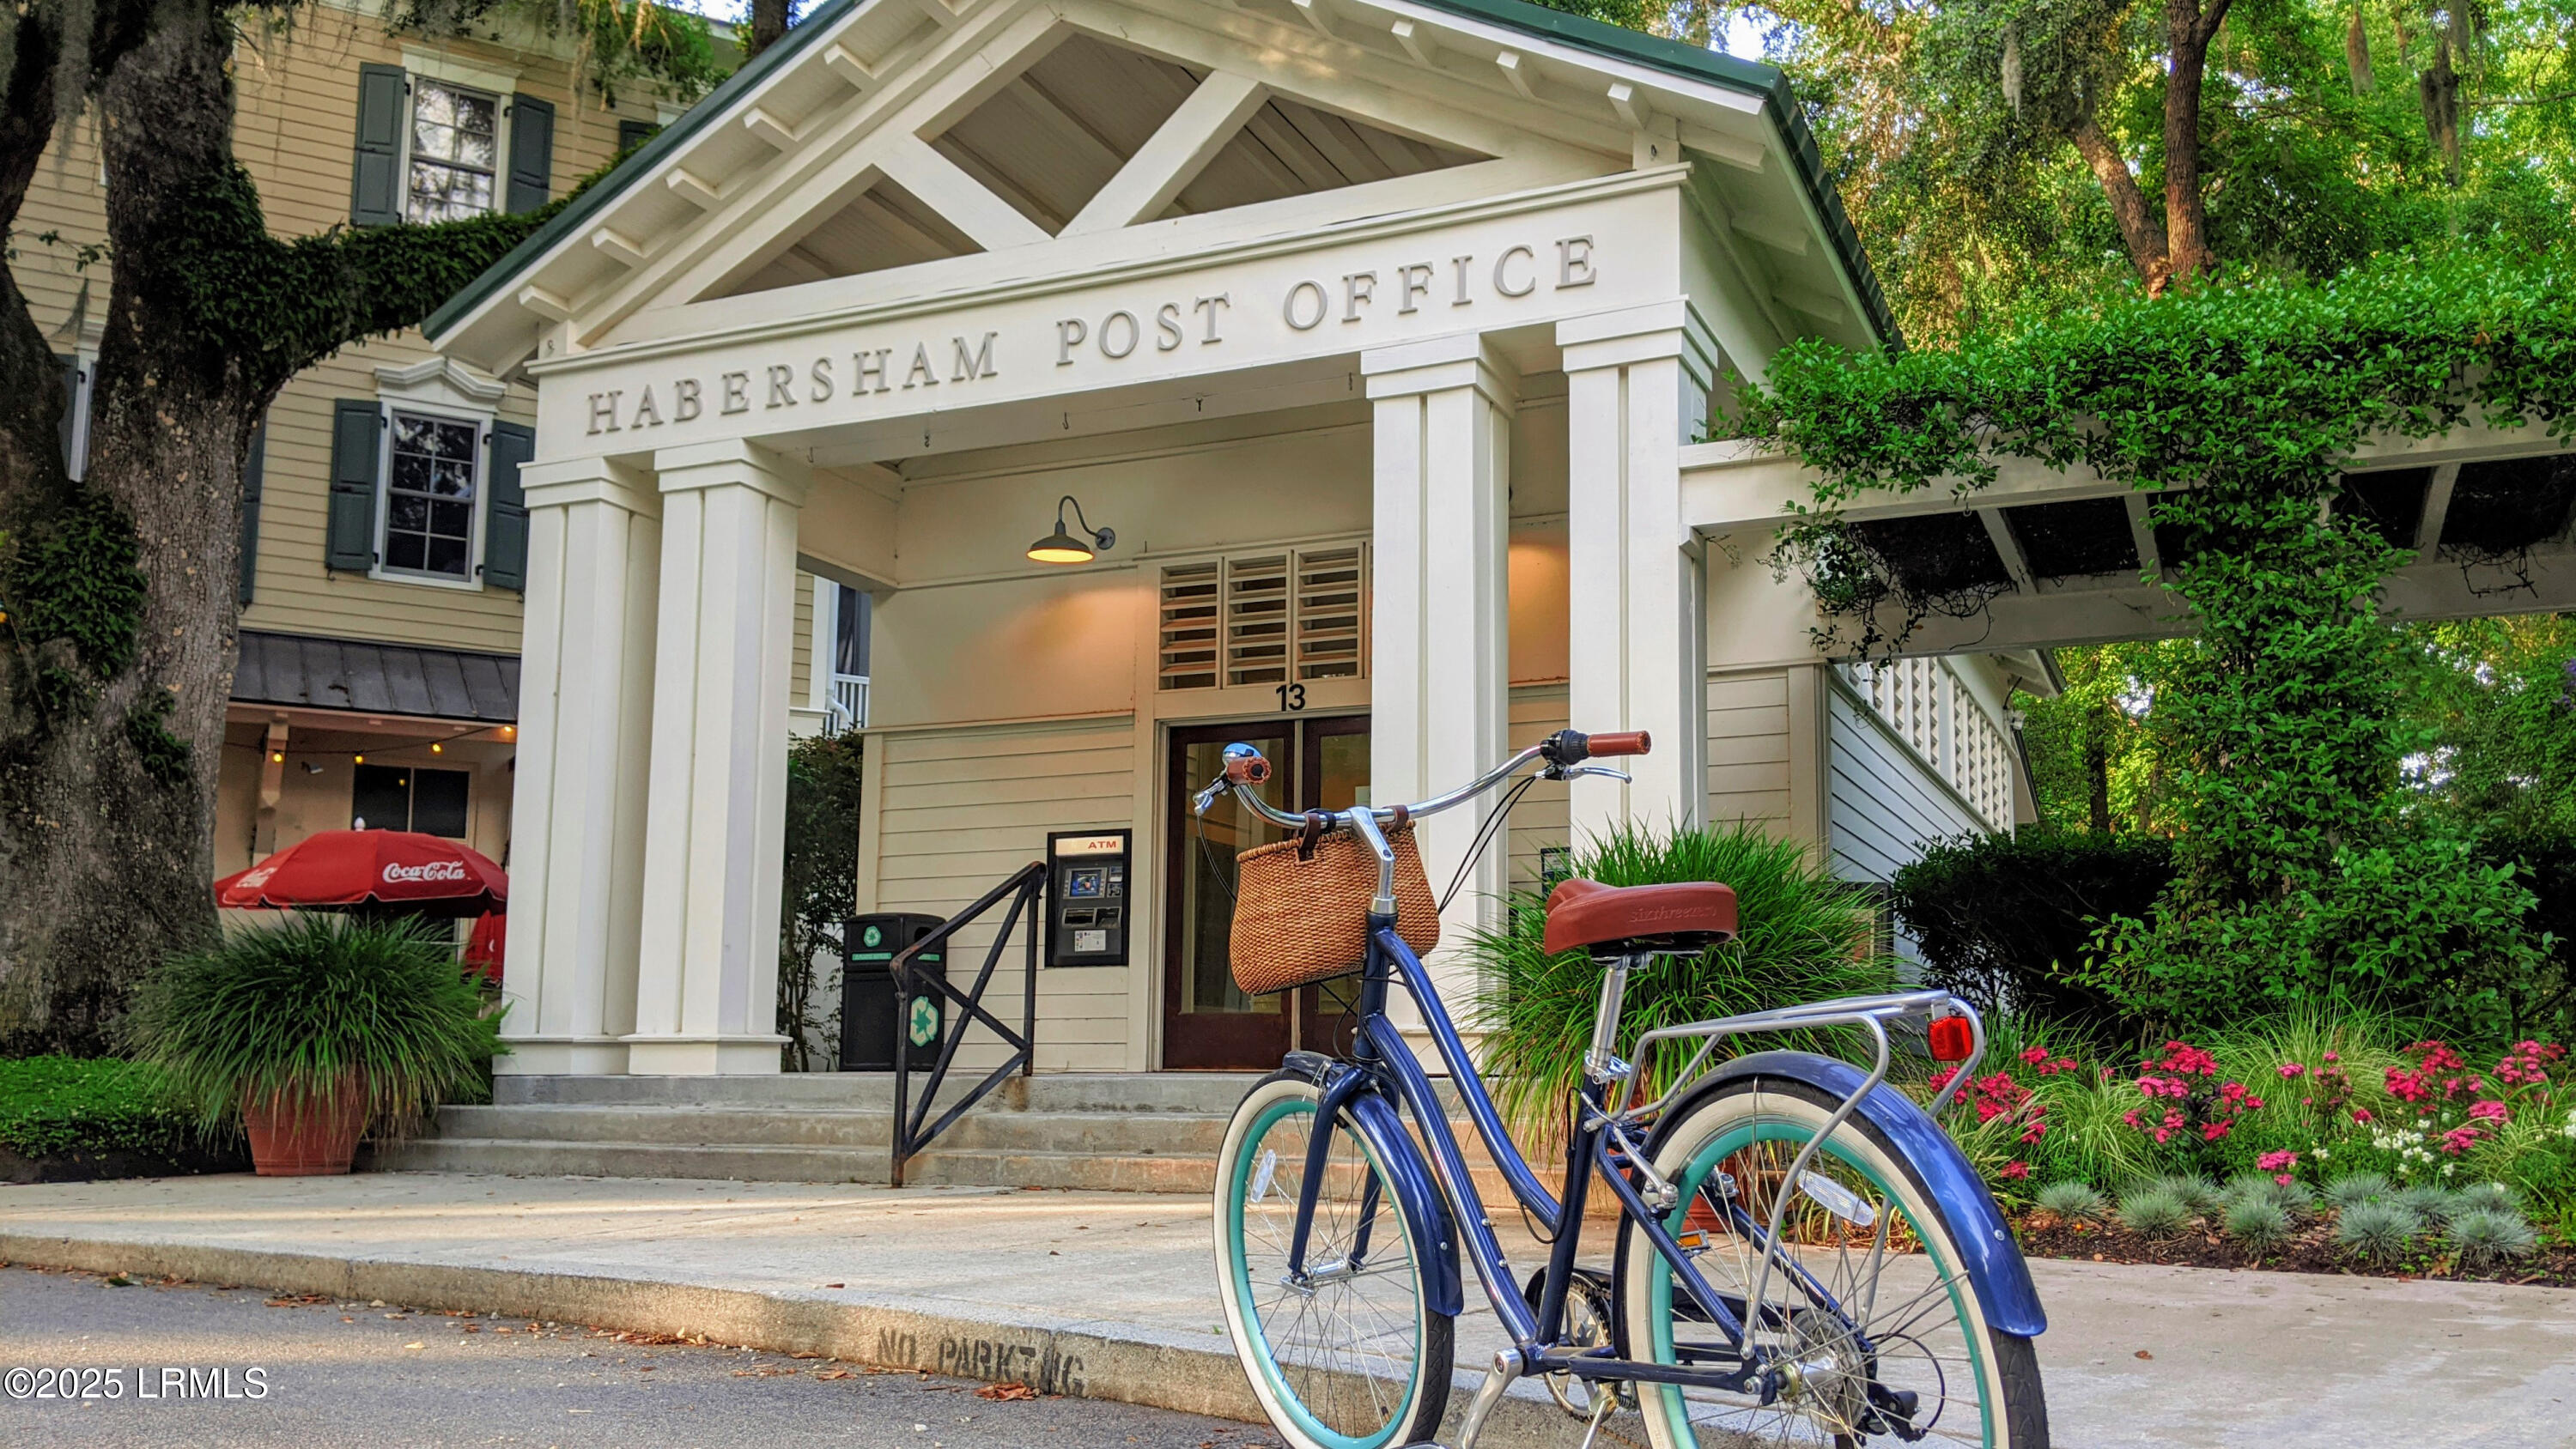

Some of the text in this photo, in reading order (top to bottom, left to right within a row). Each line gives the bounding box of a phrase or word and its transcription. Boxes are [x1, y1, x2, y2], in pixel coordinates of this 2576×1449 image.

[586, 233, 1597, 435] HABERSHAM POST OFFICE
[1275, 683, 1306, 712] 13
[1088, 840, 1117, 849] ATM
[382, 860, 465, 883] Coca-Cola
[876, 1326, 916, 1366] NO
